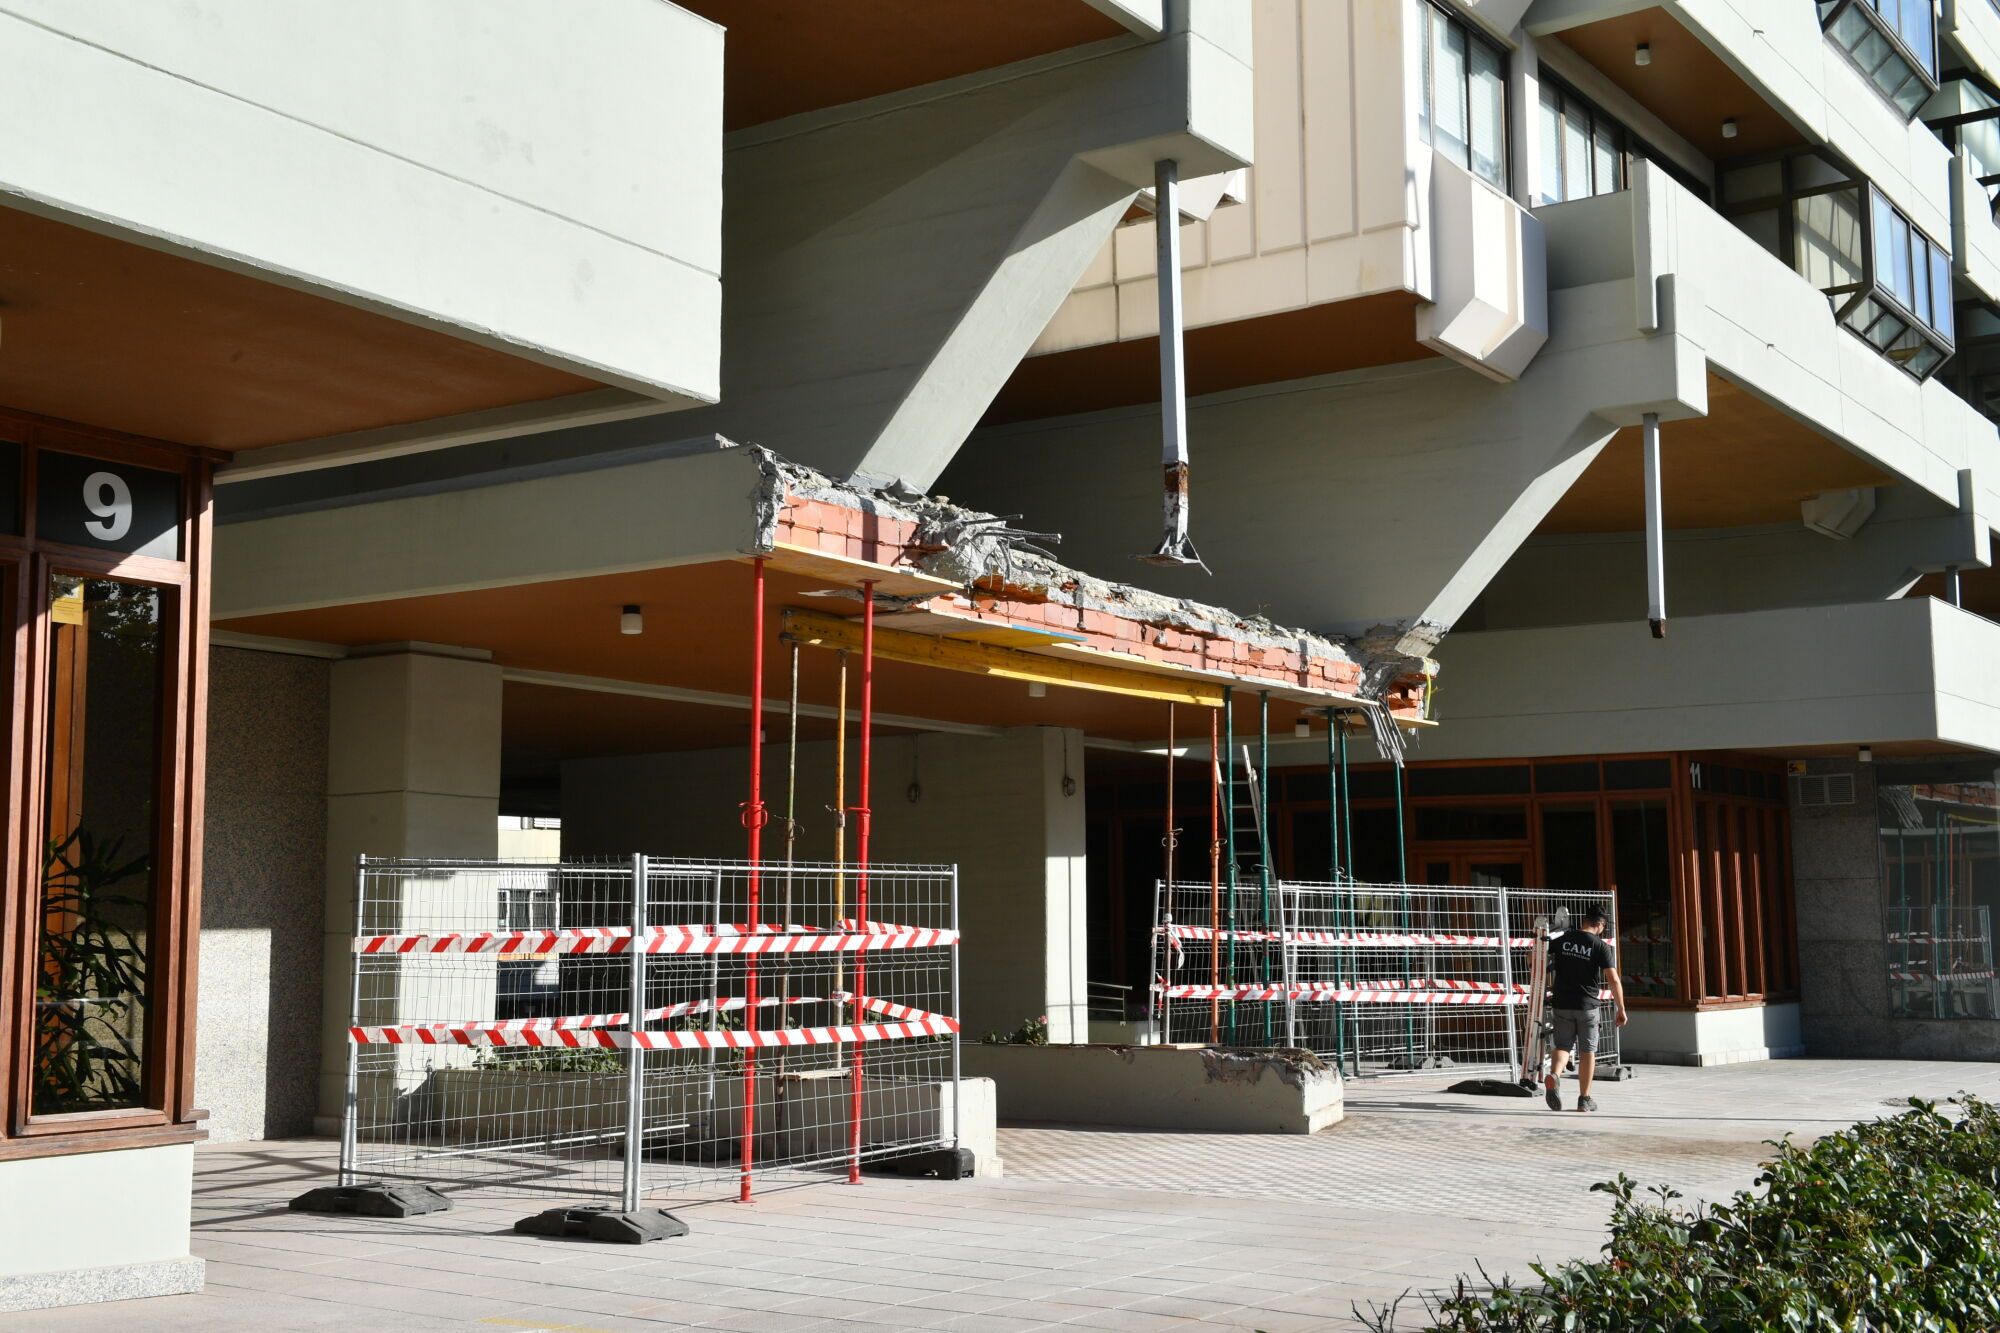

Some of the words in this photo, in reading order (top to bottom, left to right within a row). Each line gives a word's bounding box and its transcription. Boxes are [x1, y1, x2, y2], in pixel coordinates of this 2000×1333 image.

[83, 471, 133, 541] 9
[1689, 762, 1701, 789] 11
[1562, 941, 1592, 957] CAM
